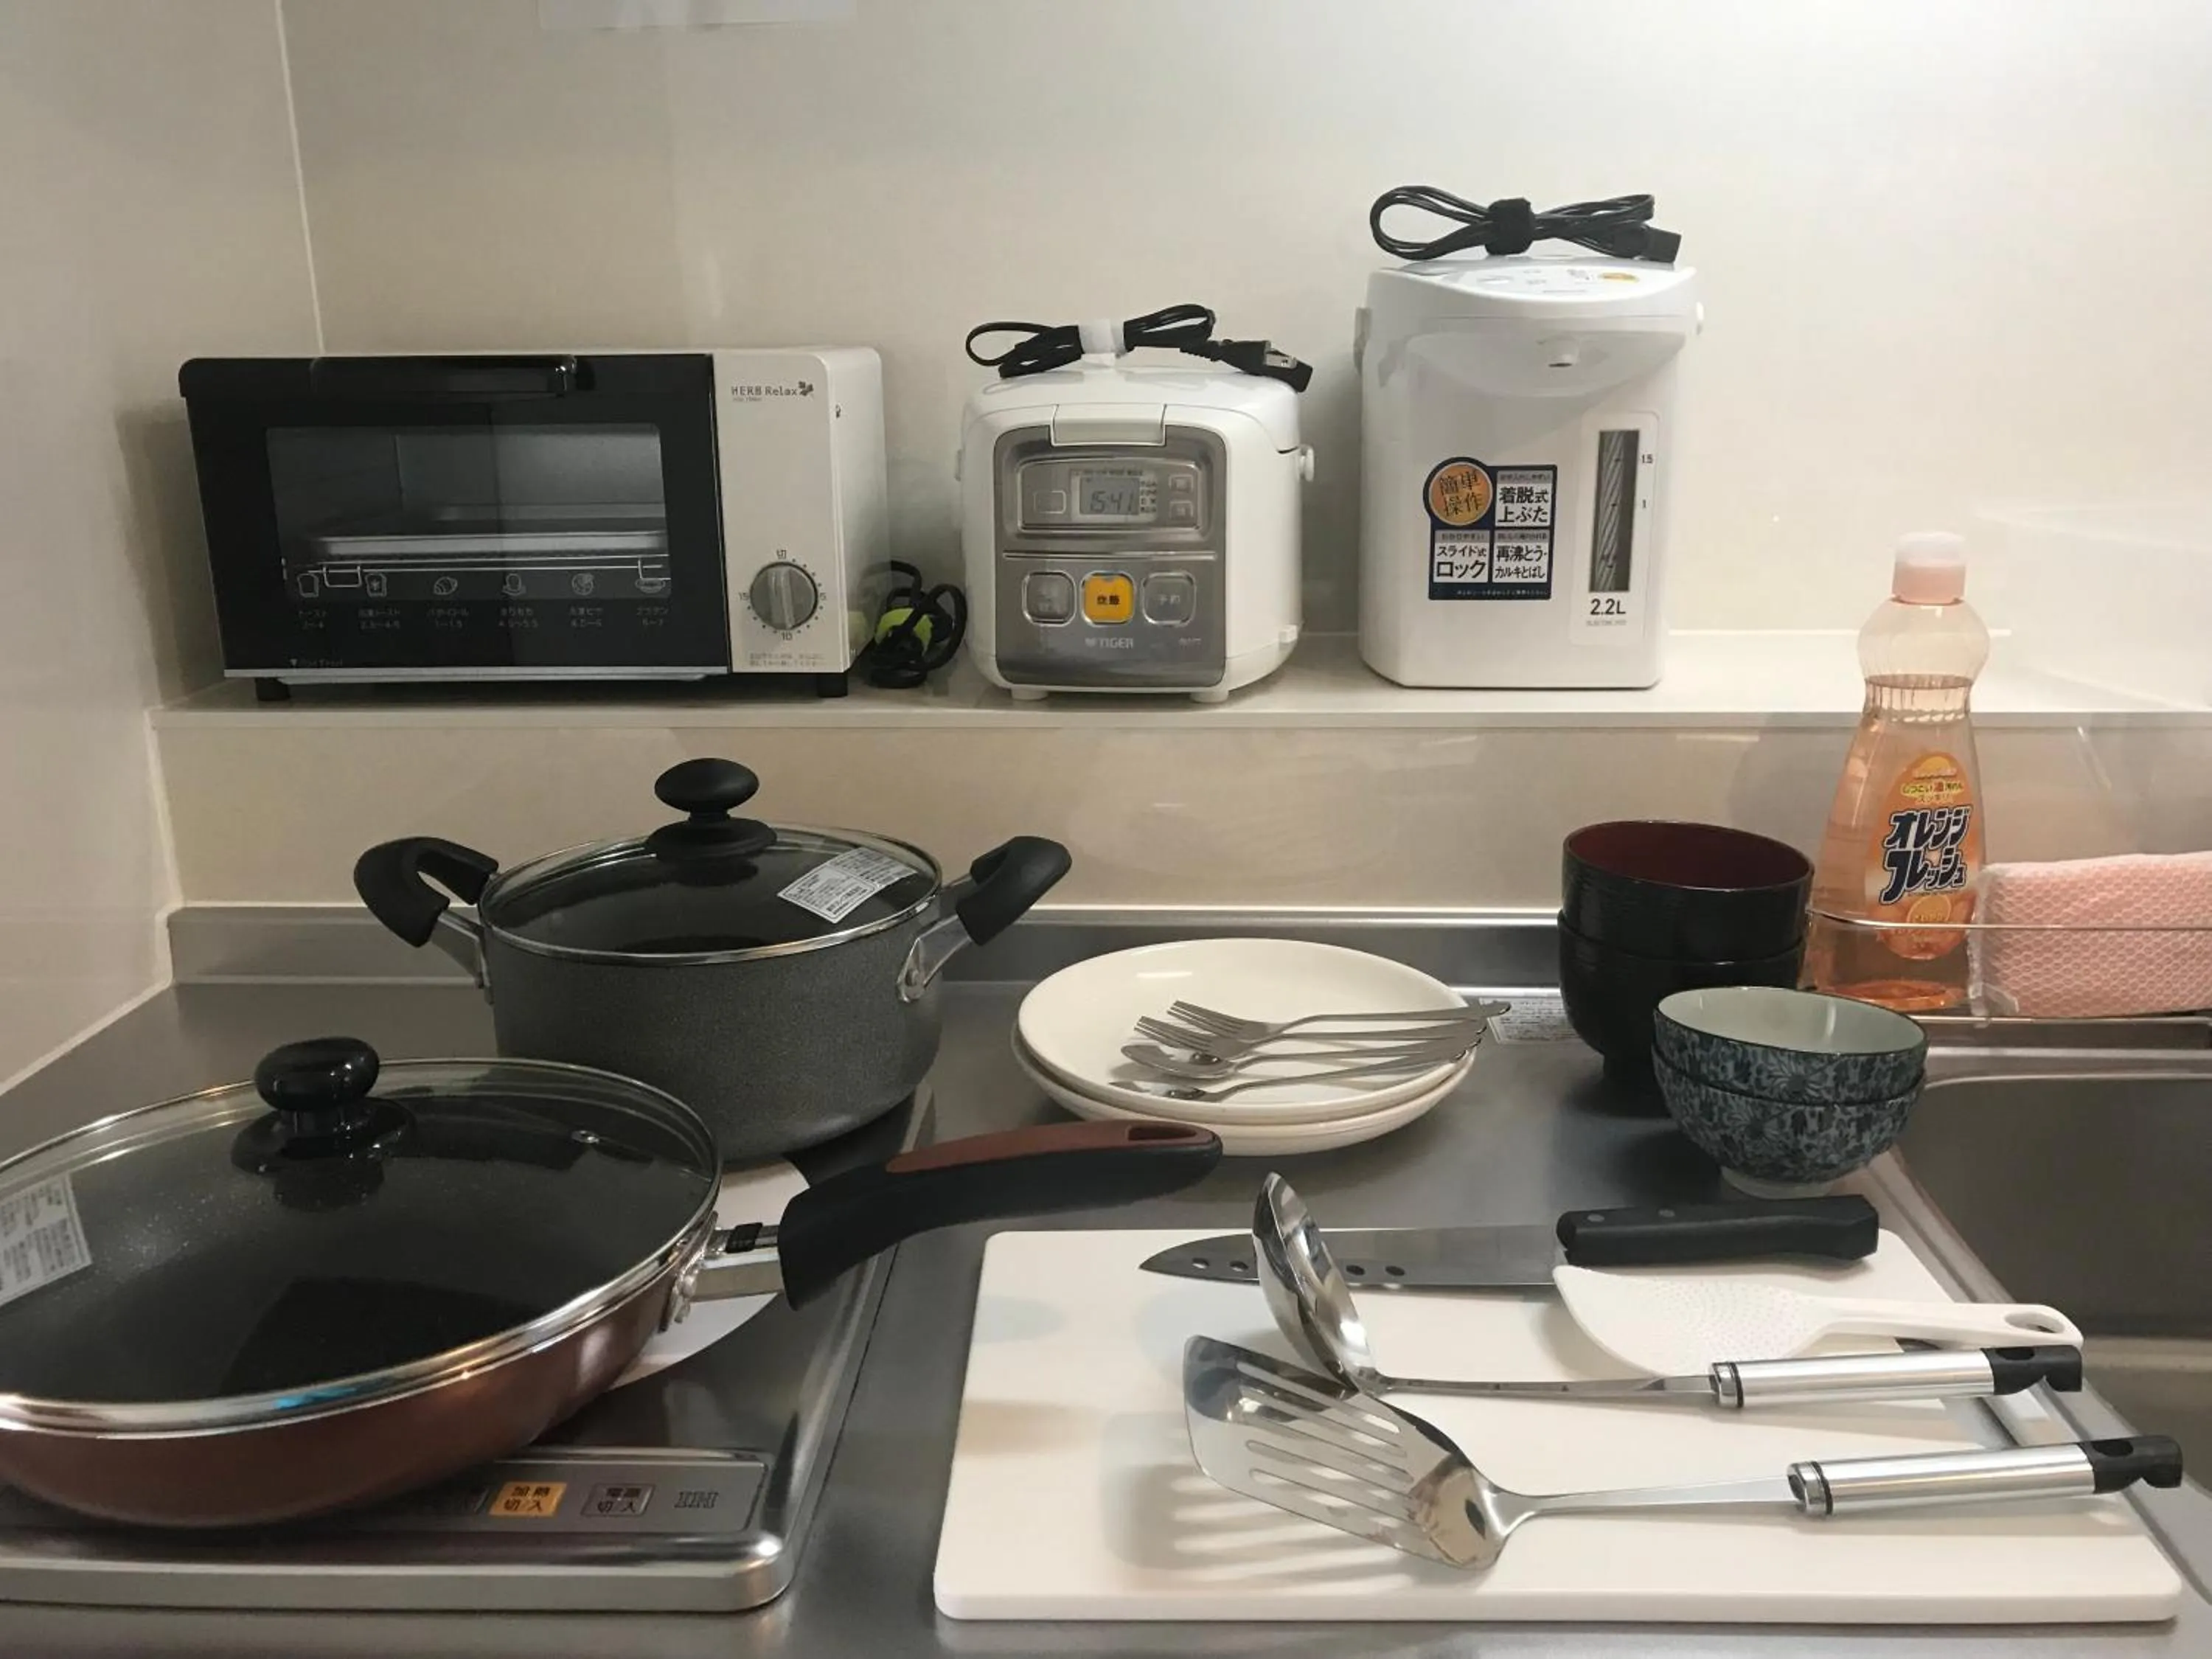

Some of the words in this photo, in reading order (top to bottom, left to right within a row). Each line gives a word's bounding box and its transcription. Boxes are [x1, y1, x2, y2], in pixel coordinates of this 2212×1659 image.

[731, 386, 762, 397] HERB
[765, 385, 798, 397] Relax
[1498, 486, 1549, 504] 着脱式
[1498, 505, 1548, 523] 上ぶた
[1436, 545, 1487, 557] スライド式
[1436, 560, 1487, 579] ロック
[1495, 566, 1545, 579] カルキとばし
[1590, 598, 1627, 616] 2.2L
[782, 631, 793, 641] 10
[1099, 637, 1134, 649] TIGER
[1882, 804, 1973, 849] オレンジ
[1879, 846, 1968, 905] フレッシュ
